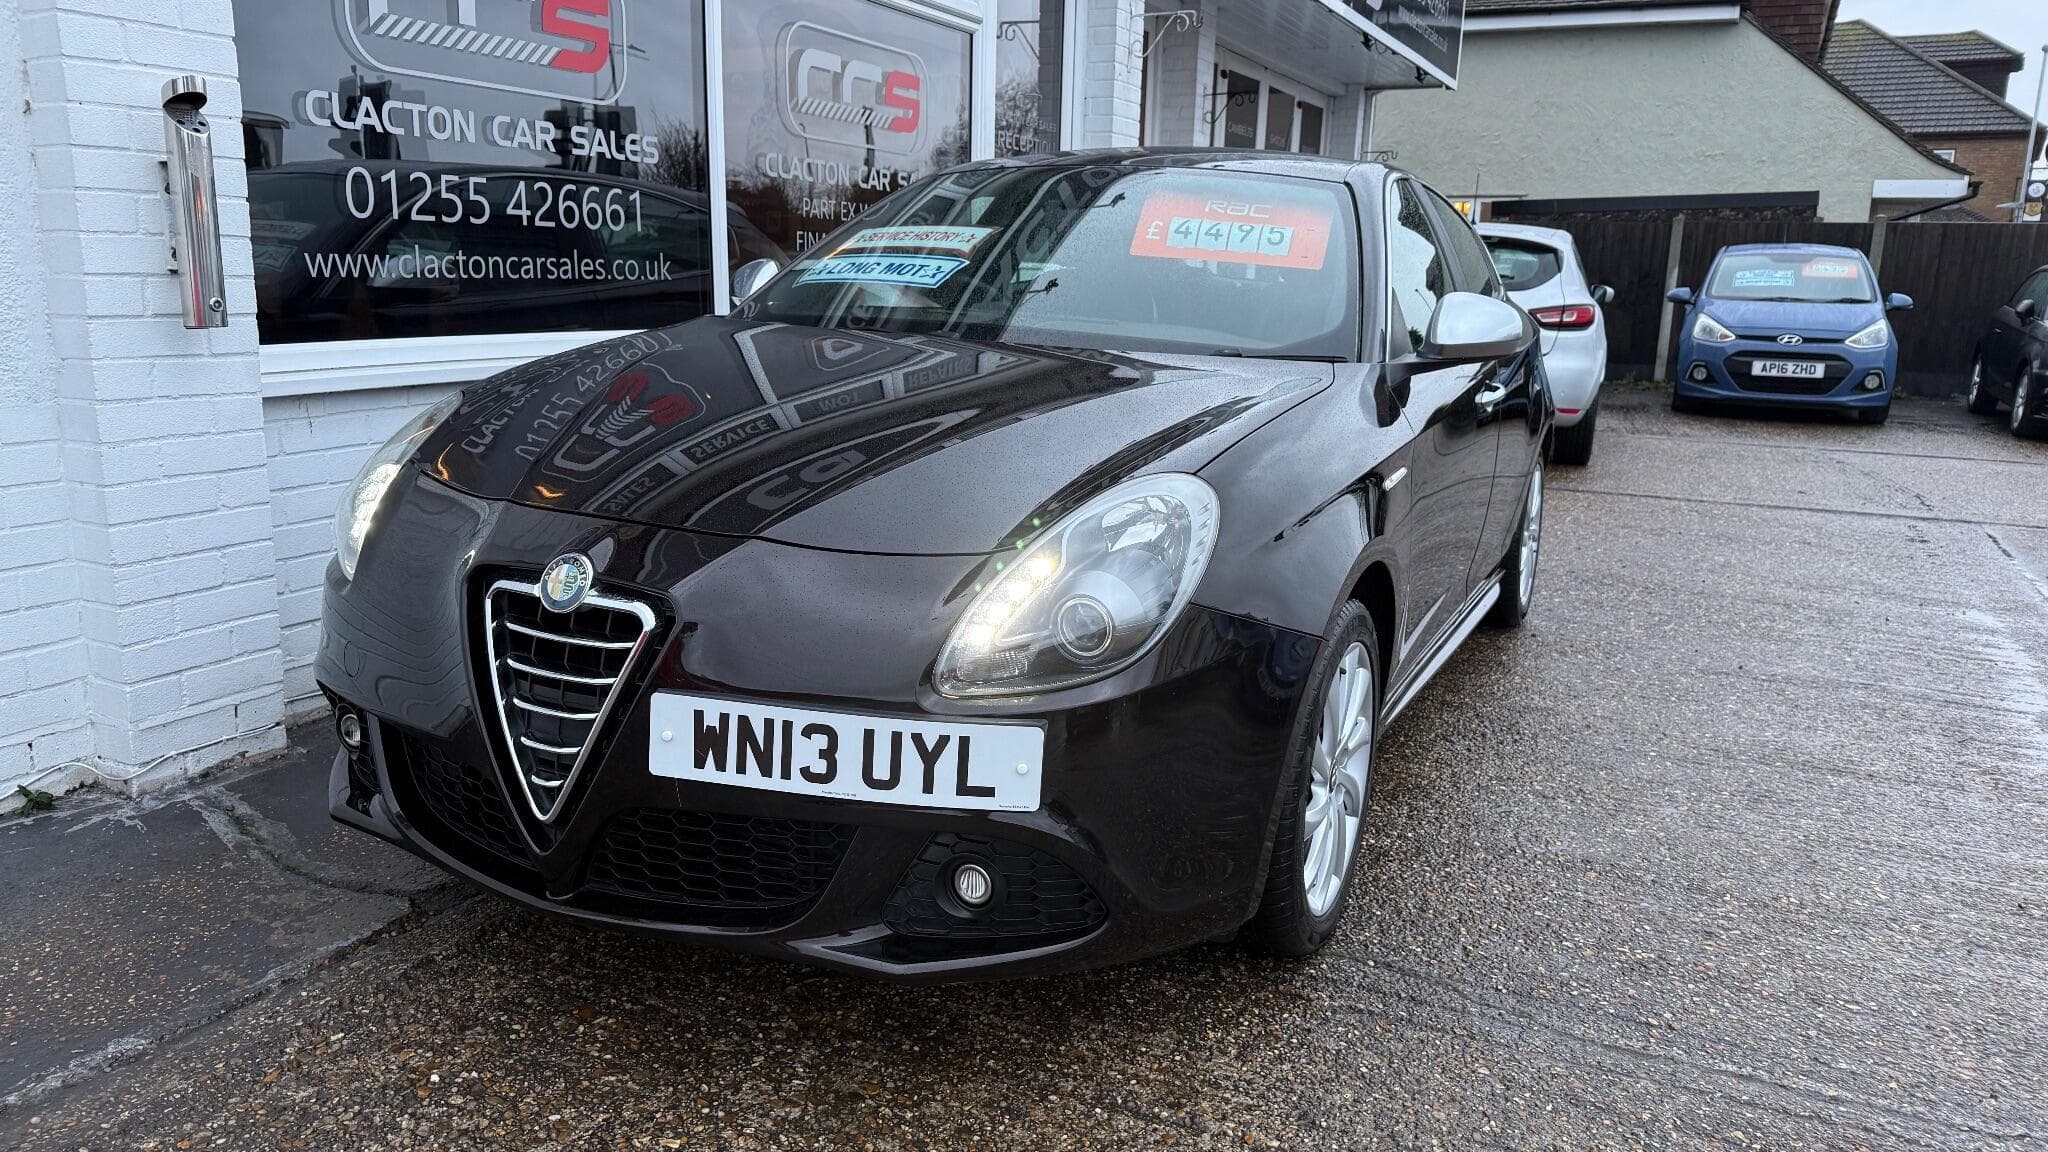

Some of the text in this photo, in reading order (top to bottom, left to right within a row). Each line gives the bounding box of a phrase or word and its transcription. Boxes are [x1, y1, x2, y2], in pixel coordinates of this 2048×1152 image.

[797, 48, 921, 133] CCS
[305, 89, 660, 165] CLACTON CAR SALES
[765, 153, 920, 192] CLACTON CAR SA
[345, 166, 644, 232] 01255 426661
[802, 197, 837, 221] PART
[840, 201, 856, 222] EX
[863, 231, 961, 242] SERVICE HISTORY
[1145, 219, 1286, 246] £ 4495
[304, 245, 672, 282] www.clactoncarsales.co.uk
[827, 262, 924, 277] LONG MOT
[1760, 361, 1817, 376] AP16 ZHD
[693, 709, 996, 798] WN13 UYL
